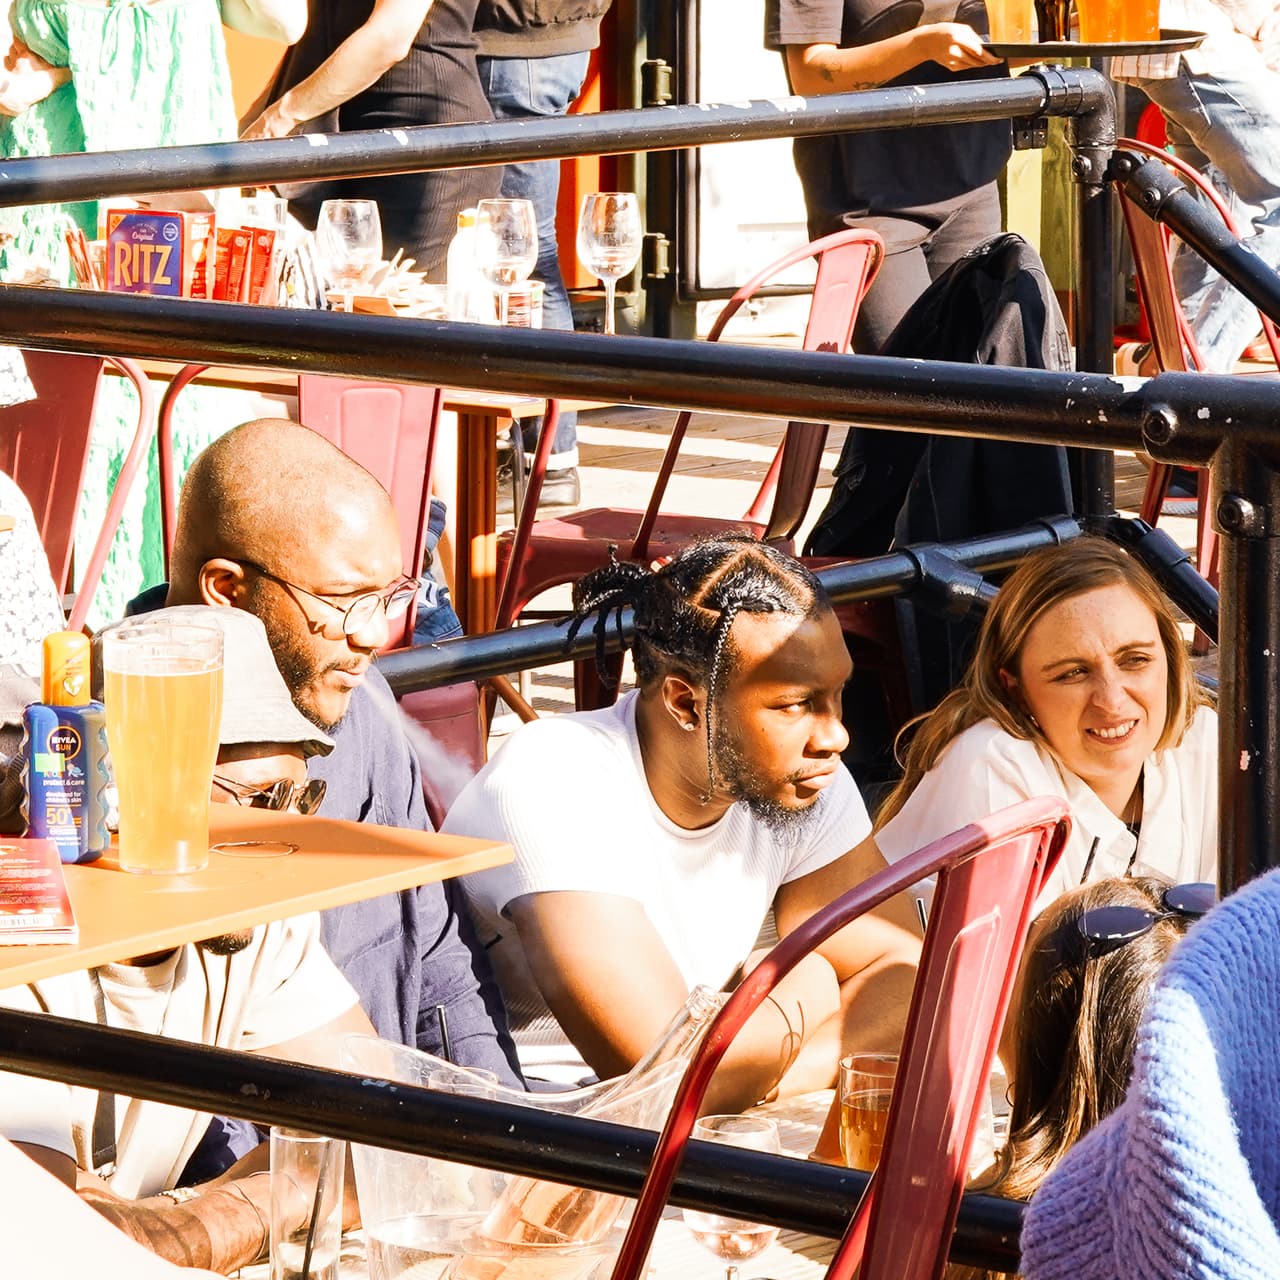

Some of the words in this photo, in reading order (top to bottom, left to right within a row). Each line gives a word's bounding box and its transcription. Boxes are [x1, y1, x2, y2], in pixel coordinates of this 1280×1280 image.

[131, 231, 155, 242] Original
[113, 240, 174, 288] RITZ
[51, 736, 77, 744] NIVEA
